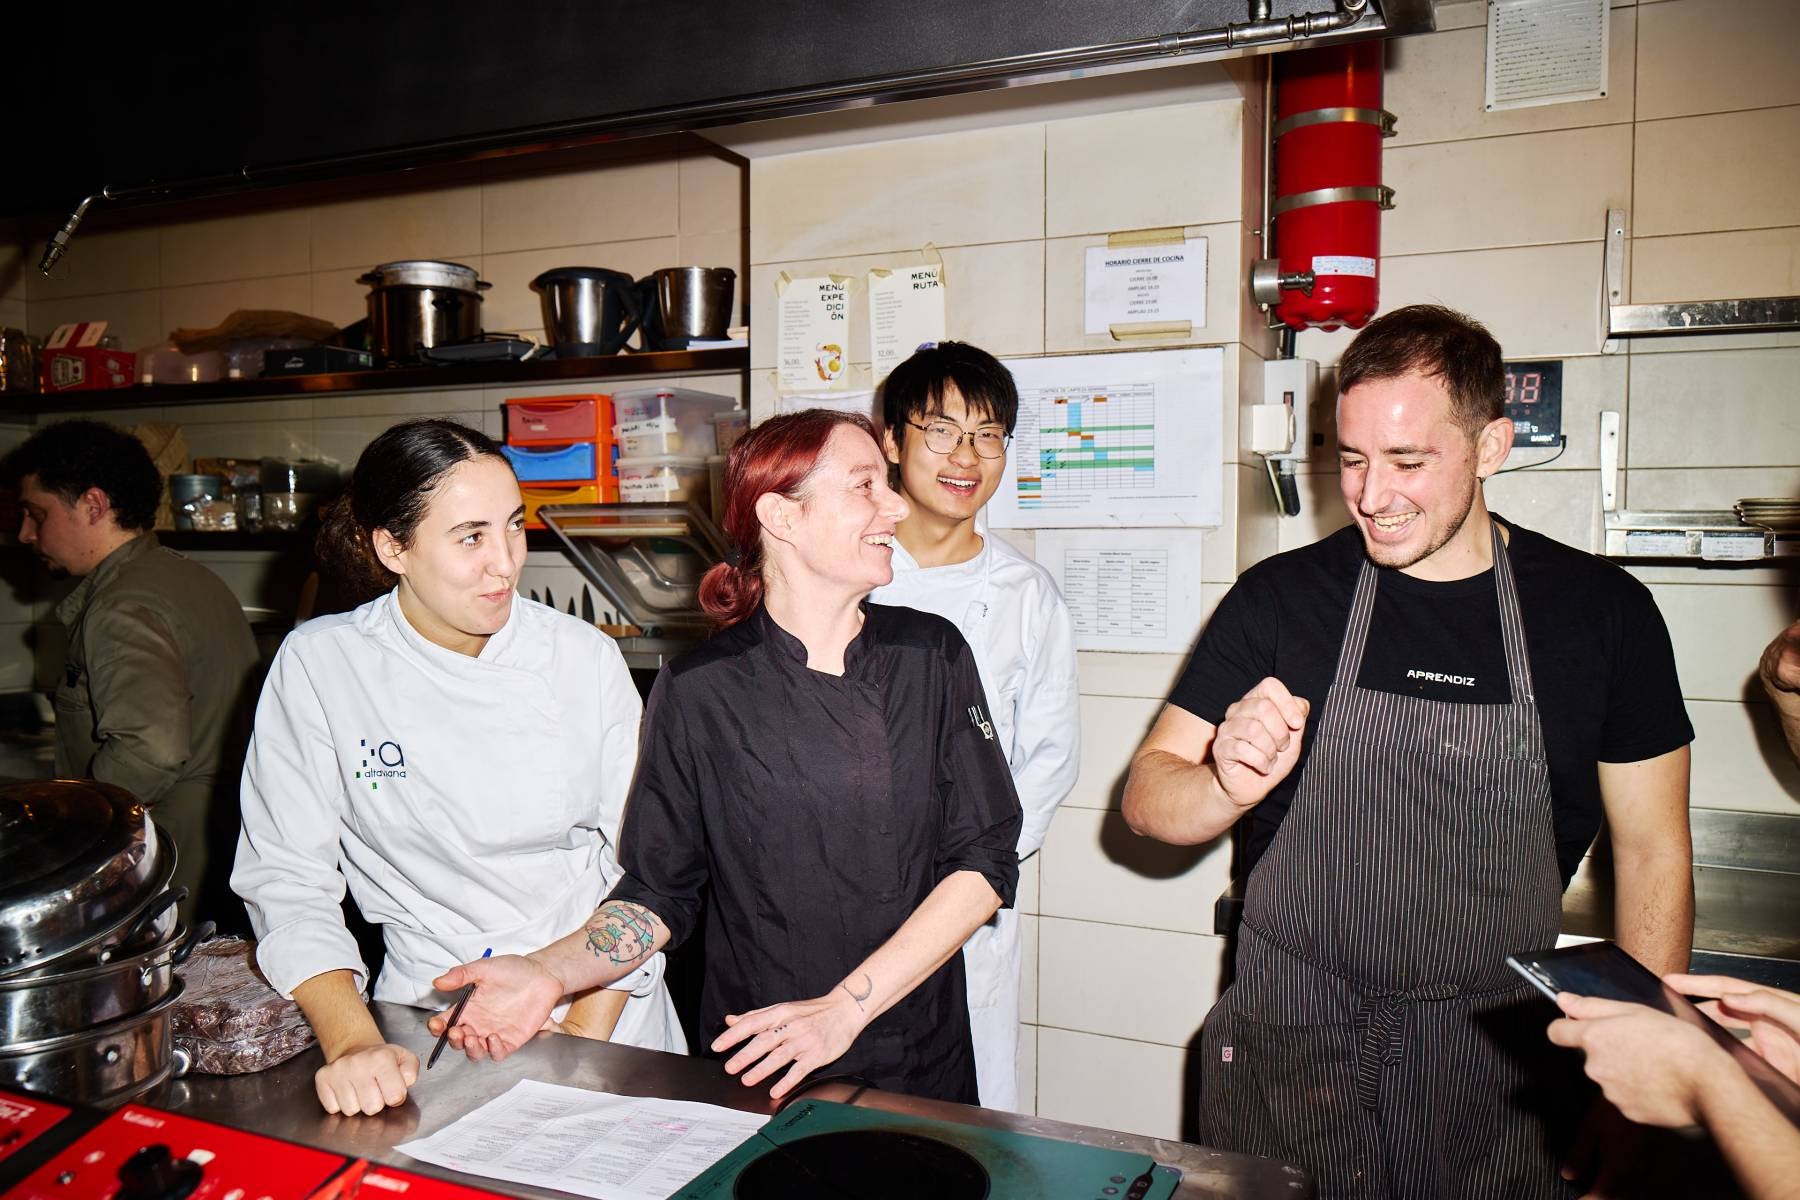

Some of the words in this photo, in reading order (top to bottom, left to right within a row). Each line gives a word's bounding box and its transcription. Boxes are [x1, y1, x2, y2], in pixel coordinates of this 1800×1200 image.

[1133, 257, 1151, 265] CIERRE
[913, 280, 939, 290] RUTA
[821, 293, 844, 301] EXPE
[826, 303, 844, 311] DICI
[1406, 669, 1476, 687] APRENDIZ
